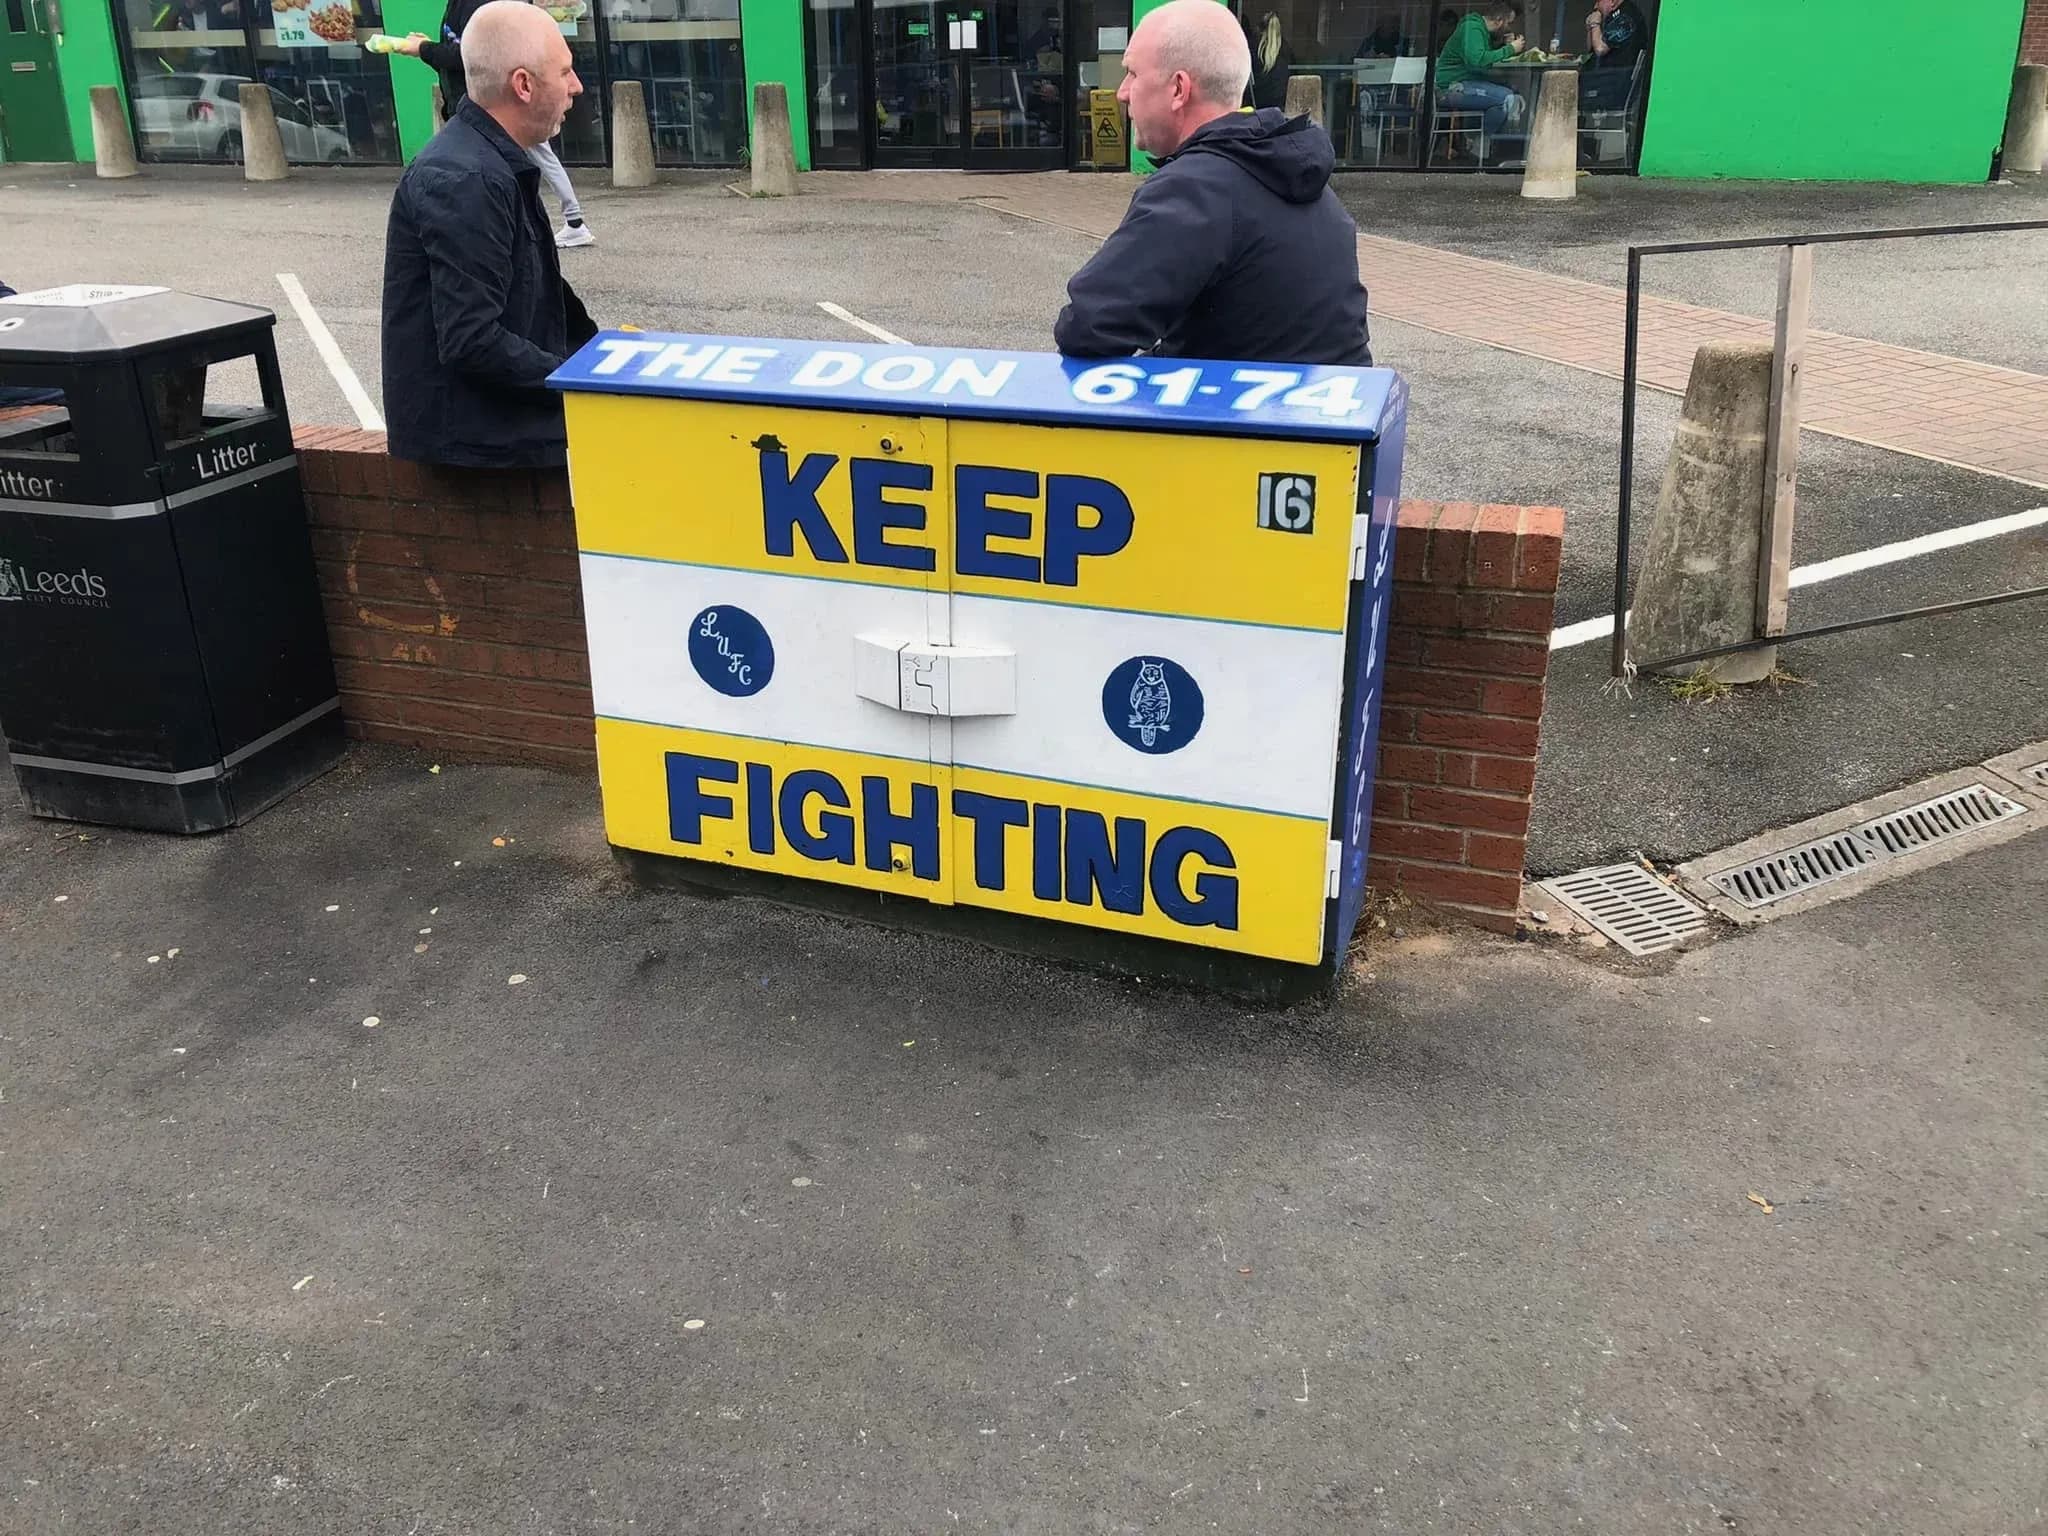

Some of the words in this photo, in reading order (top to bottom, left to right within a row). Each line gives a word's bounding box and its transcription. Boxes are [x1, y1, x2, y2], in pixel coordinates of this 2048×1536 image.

[594, 339, 765, 384] THE
[791, 349, 1018, 397] DON
[1071, 363, 1365, 419] 61-74
[0, 469, 54, 497] itter
[196, 442, 257, 479] Litter
[759, 451, 1132, 586] KEEP
[1259, 475, 1311, 529] 16
[19, 566, 106, 598] Leeds
[26, 594, 53, 603] CITY
[60, 597, 110, 608] COUNCIL
[665, 751, 1240, 931] FIGHTING
